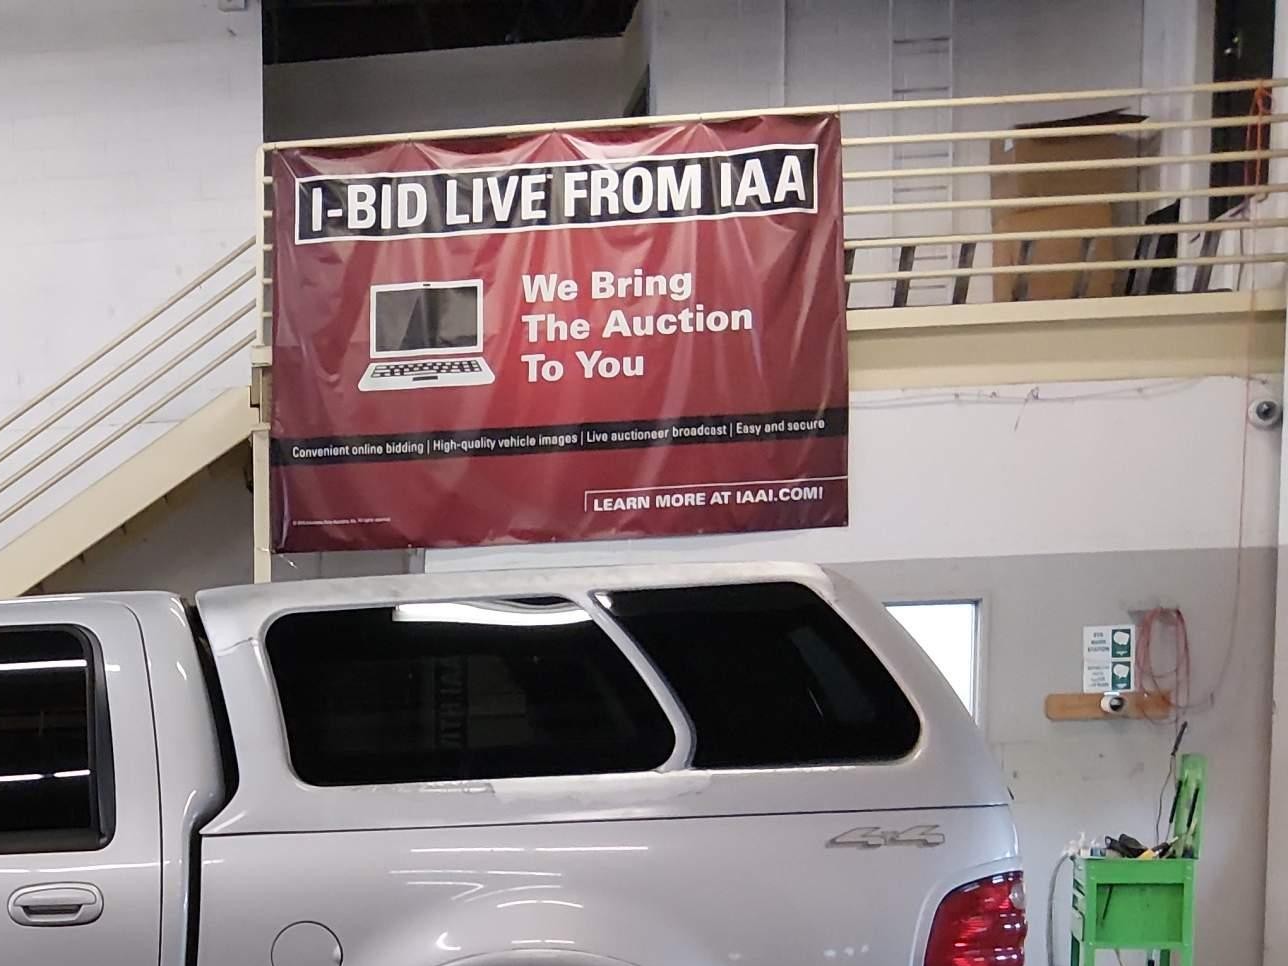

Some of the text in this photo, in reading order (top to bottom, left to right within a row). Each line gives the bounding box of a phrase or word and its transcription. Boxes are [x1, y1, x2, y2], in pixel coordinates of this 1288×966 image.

[312, 155, 807, 232] I-BID LIVE FROM IAA
[522, 268, 692, 303] We Bring
[521, 304, 753, 343] The Auction
[520, 350, 645, 383] To You
[292, 444, 350, 458] Convenient
[351, 443, 383, 456] online
[386, 441, 424, 454] bidding
[433, 436, 496, 453] High-quality
[498, 435, 536, 448] vehicle
[538, 433, 578, 447] images
[586, 431, 608, 443] Live
[611, 427, 670, 442] auctioneer
[672, 423, 728, 438] broadcast
[736, 422, 762, 436] Easy
[764, 420, 785, 433] and
[787, 418, 825, 431] secure
[593, 486, 824, 512] LEARN MORE AT IAAI.COM!
